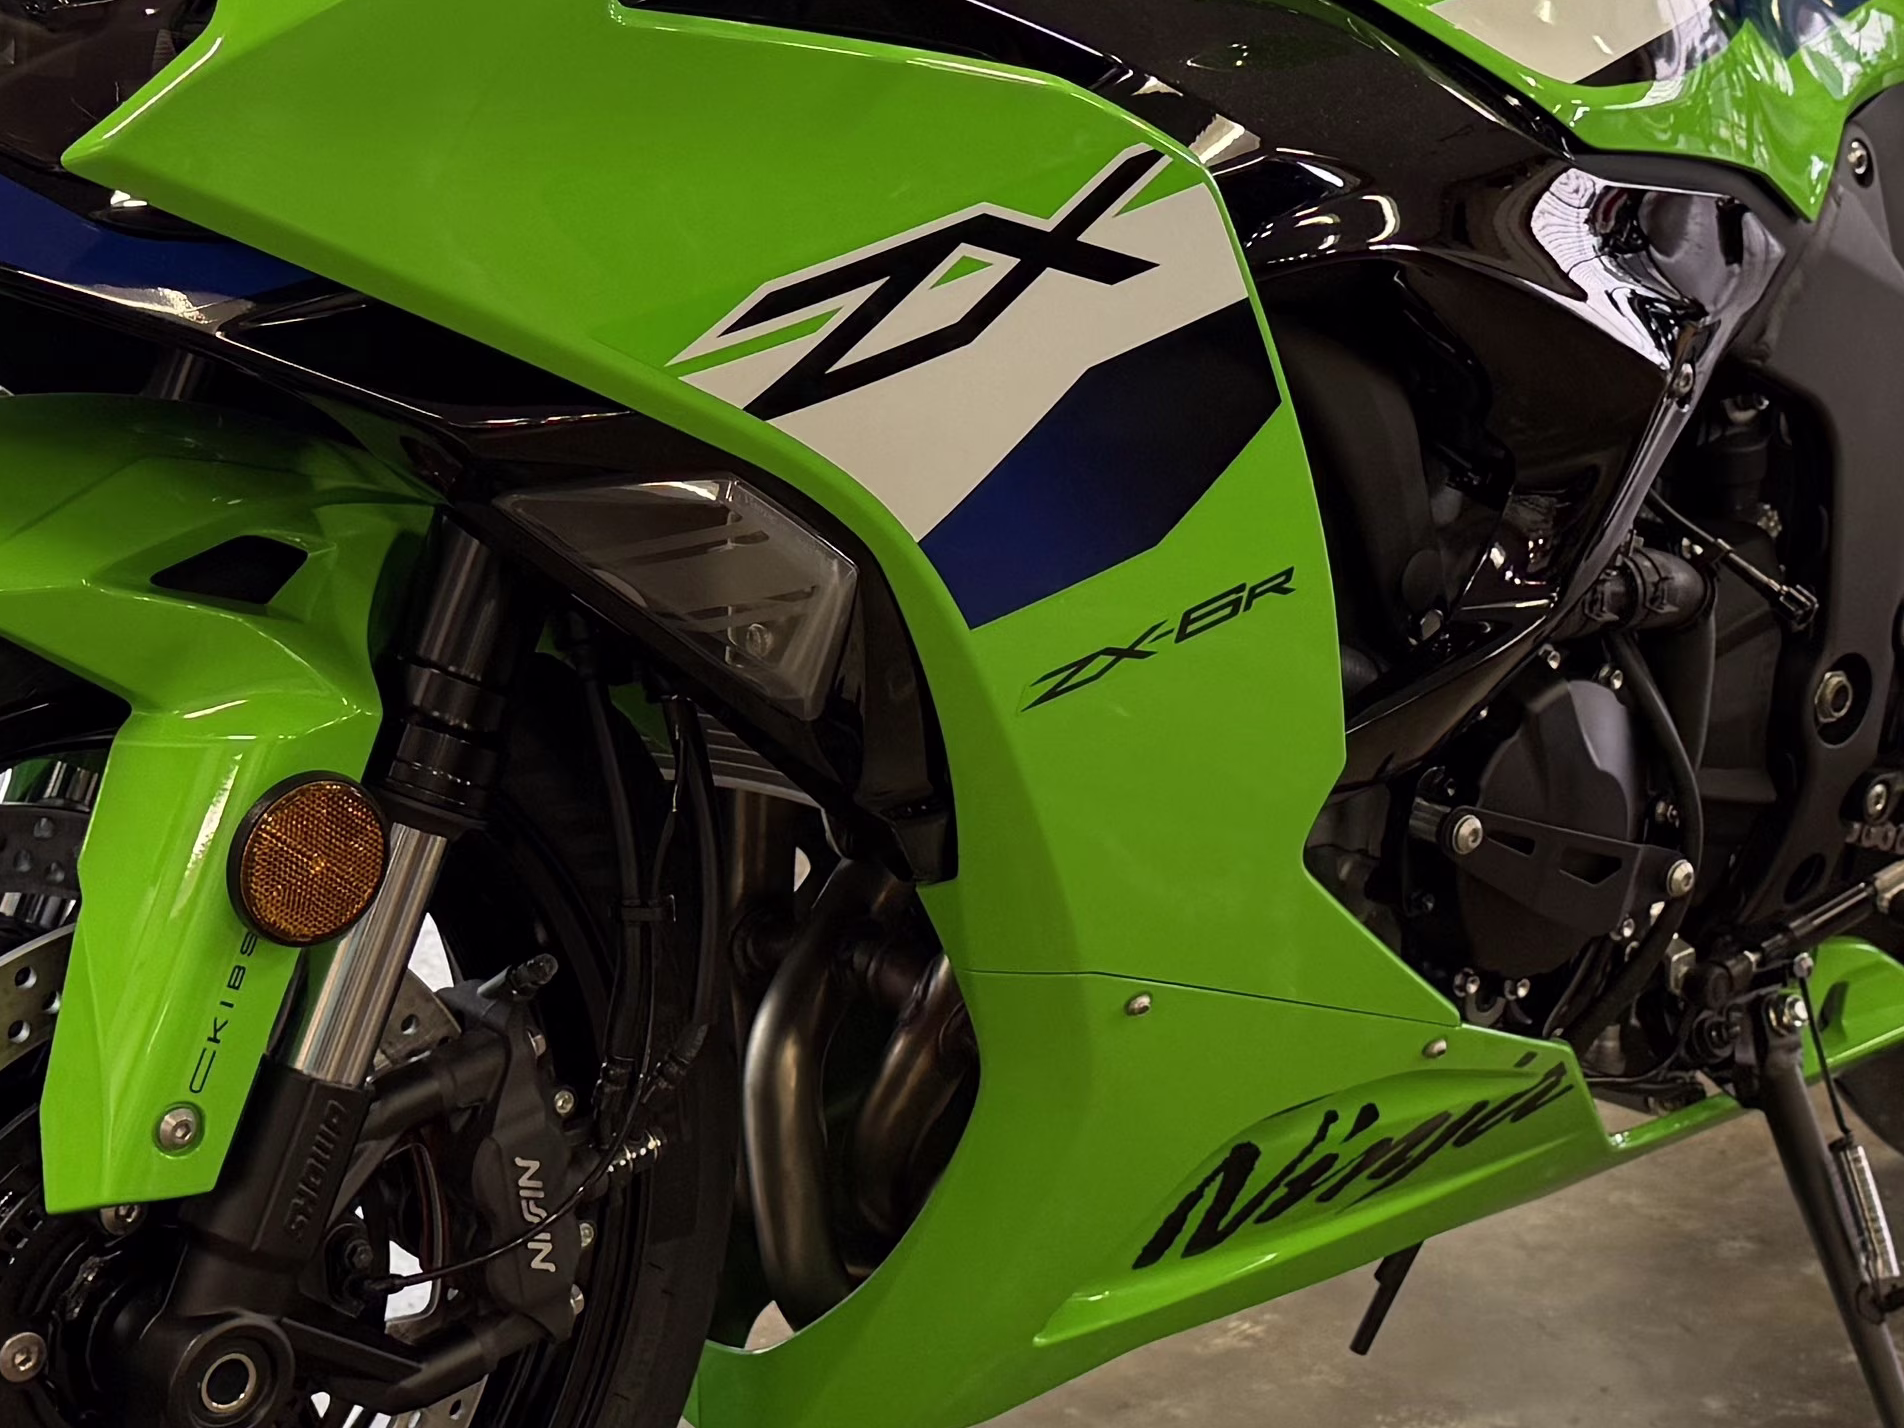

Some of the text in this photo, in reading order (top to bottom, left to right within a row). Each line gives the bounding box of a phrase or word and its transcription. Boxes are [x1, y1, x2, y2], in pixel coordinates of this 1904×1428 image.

[714, 148, 1162, 422] ZX
[1020, 566, 1296, 712] ZX-6R
[1131, 1051, 1574, 1269] Ninja
